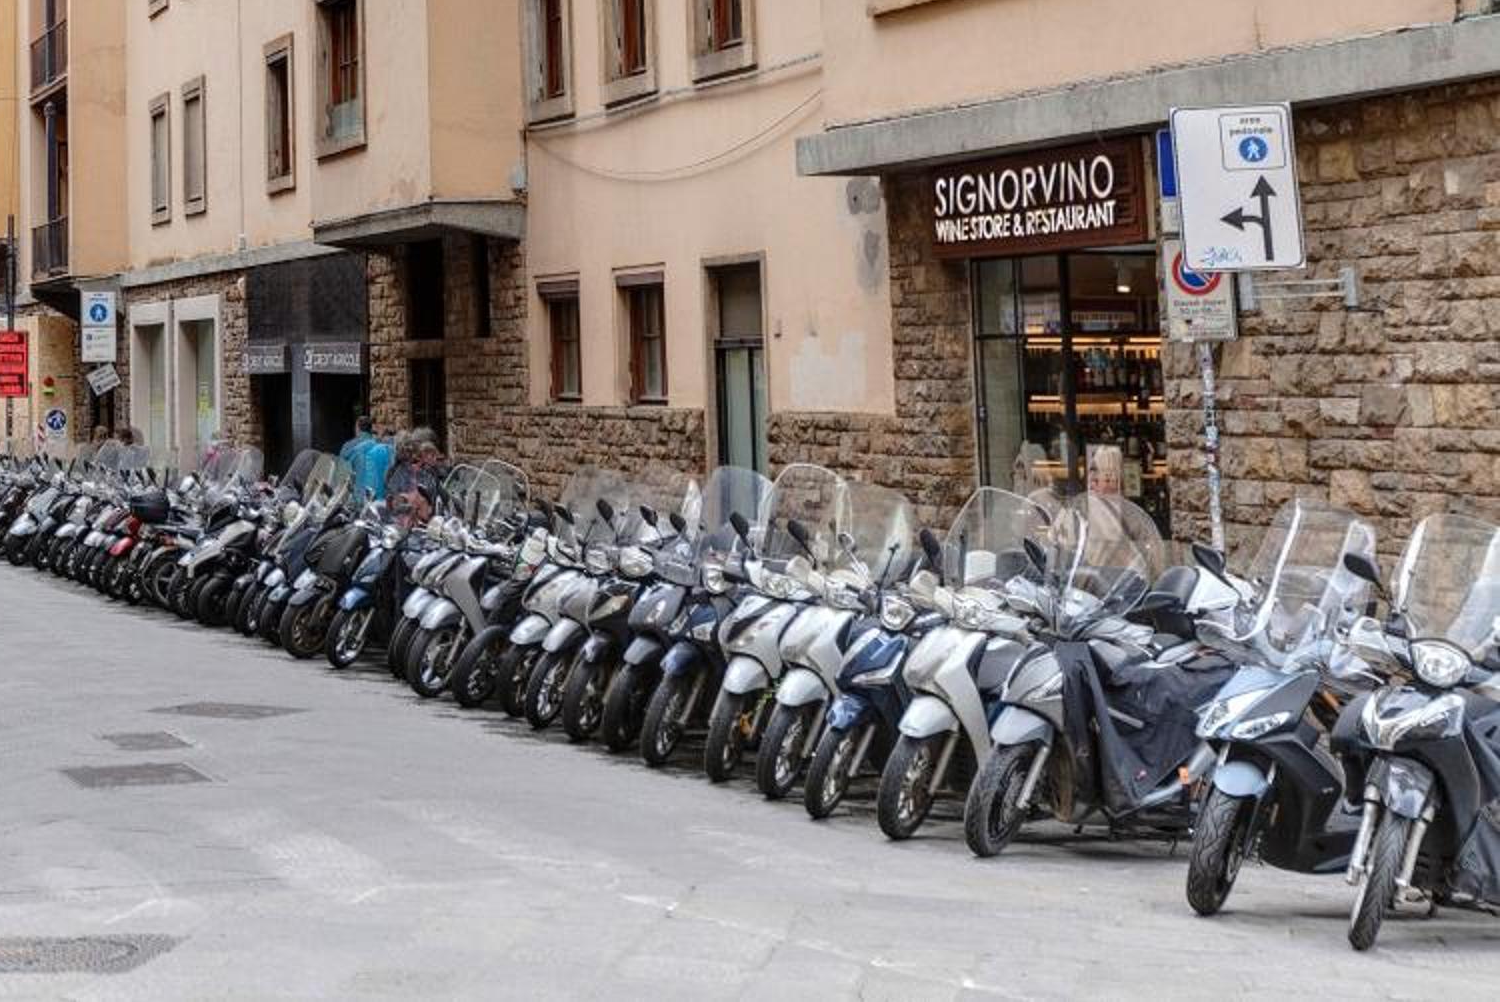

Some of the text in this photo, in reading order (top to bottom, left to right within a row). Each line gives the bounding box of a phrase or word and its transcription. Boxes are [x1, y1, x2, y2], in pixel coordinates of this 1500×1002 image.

[935, 154, 1115, 217] SIGNORVINO
[1013, 213, 1025, 237] &
[1026, 200, 1117, 235] RESTAURANT
